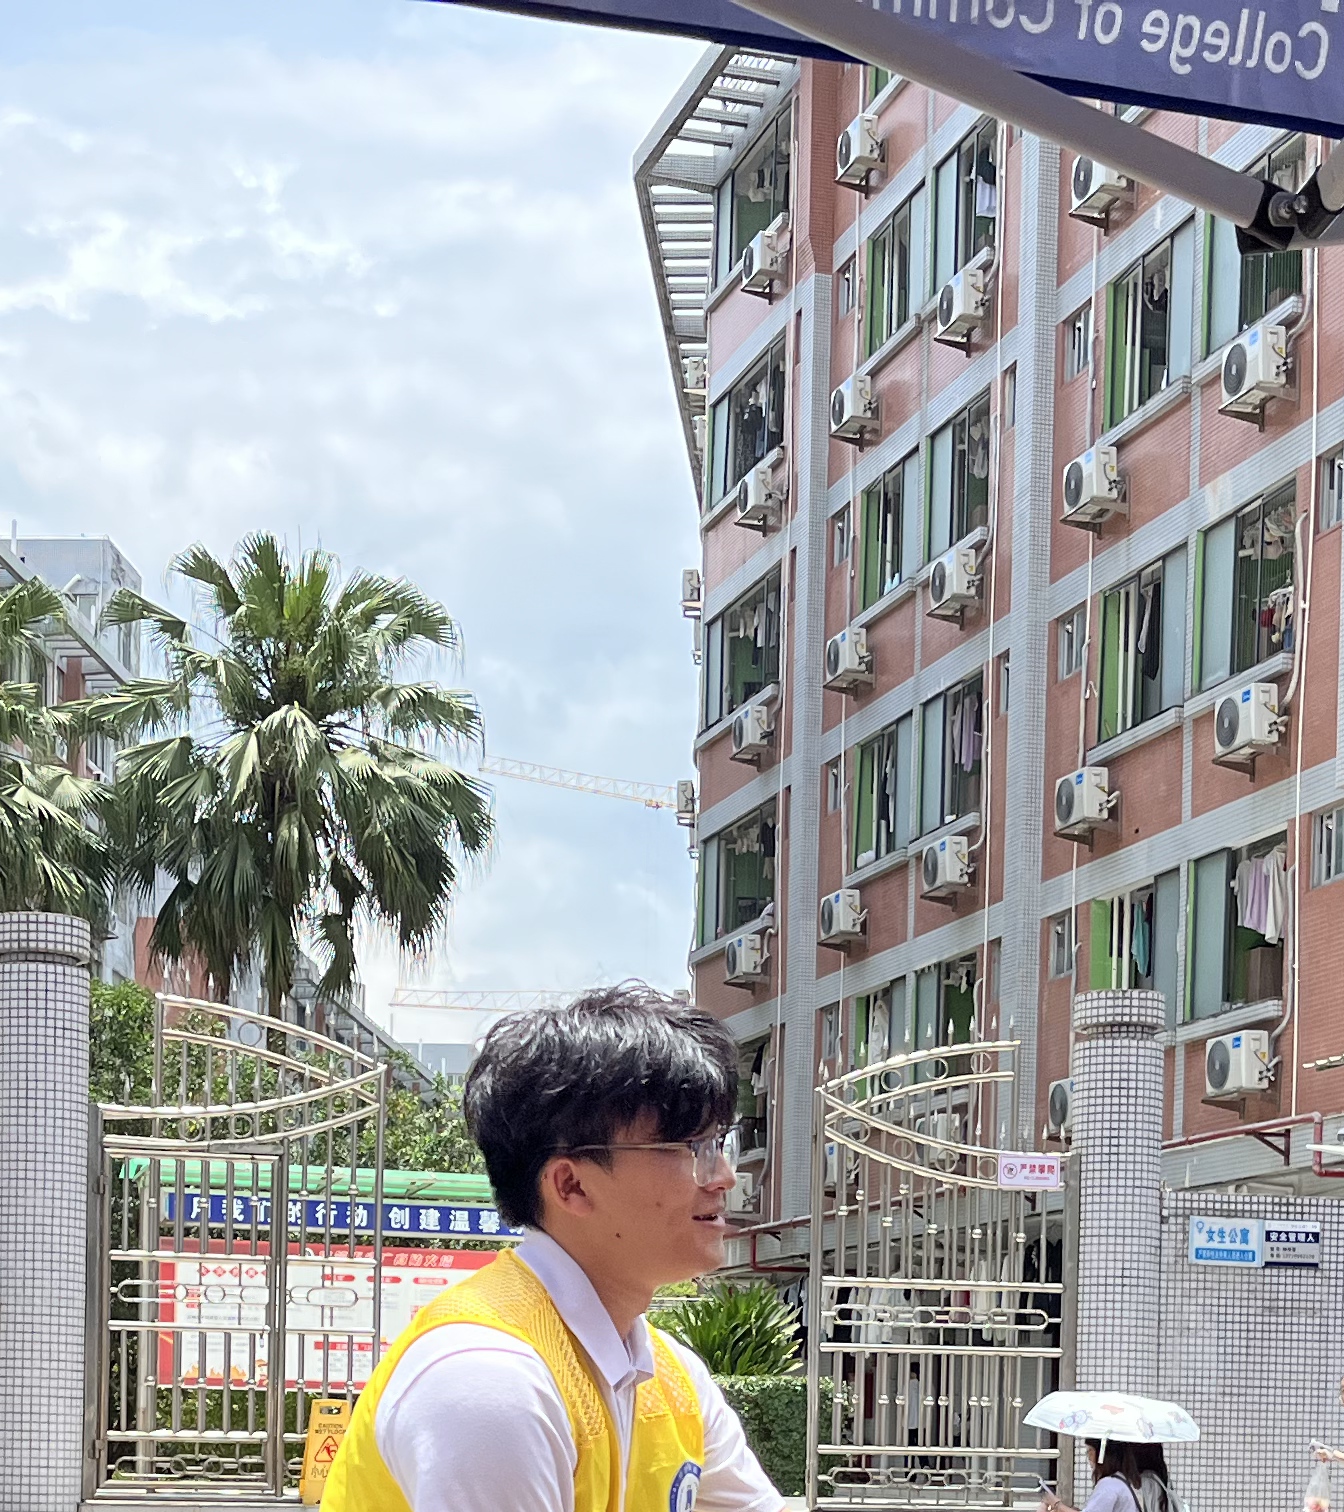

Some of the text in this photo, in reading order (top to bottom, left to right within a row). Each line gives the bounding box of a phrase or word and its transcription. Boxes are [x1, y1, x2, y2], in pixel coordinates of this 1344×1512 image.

[388, 1205, 524, 1236] 创建温馨
[1205, 1226, 1250, 1246] 女生公寓
